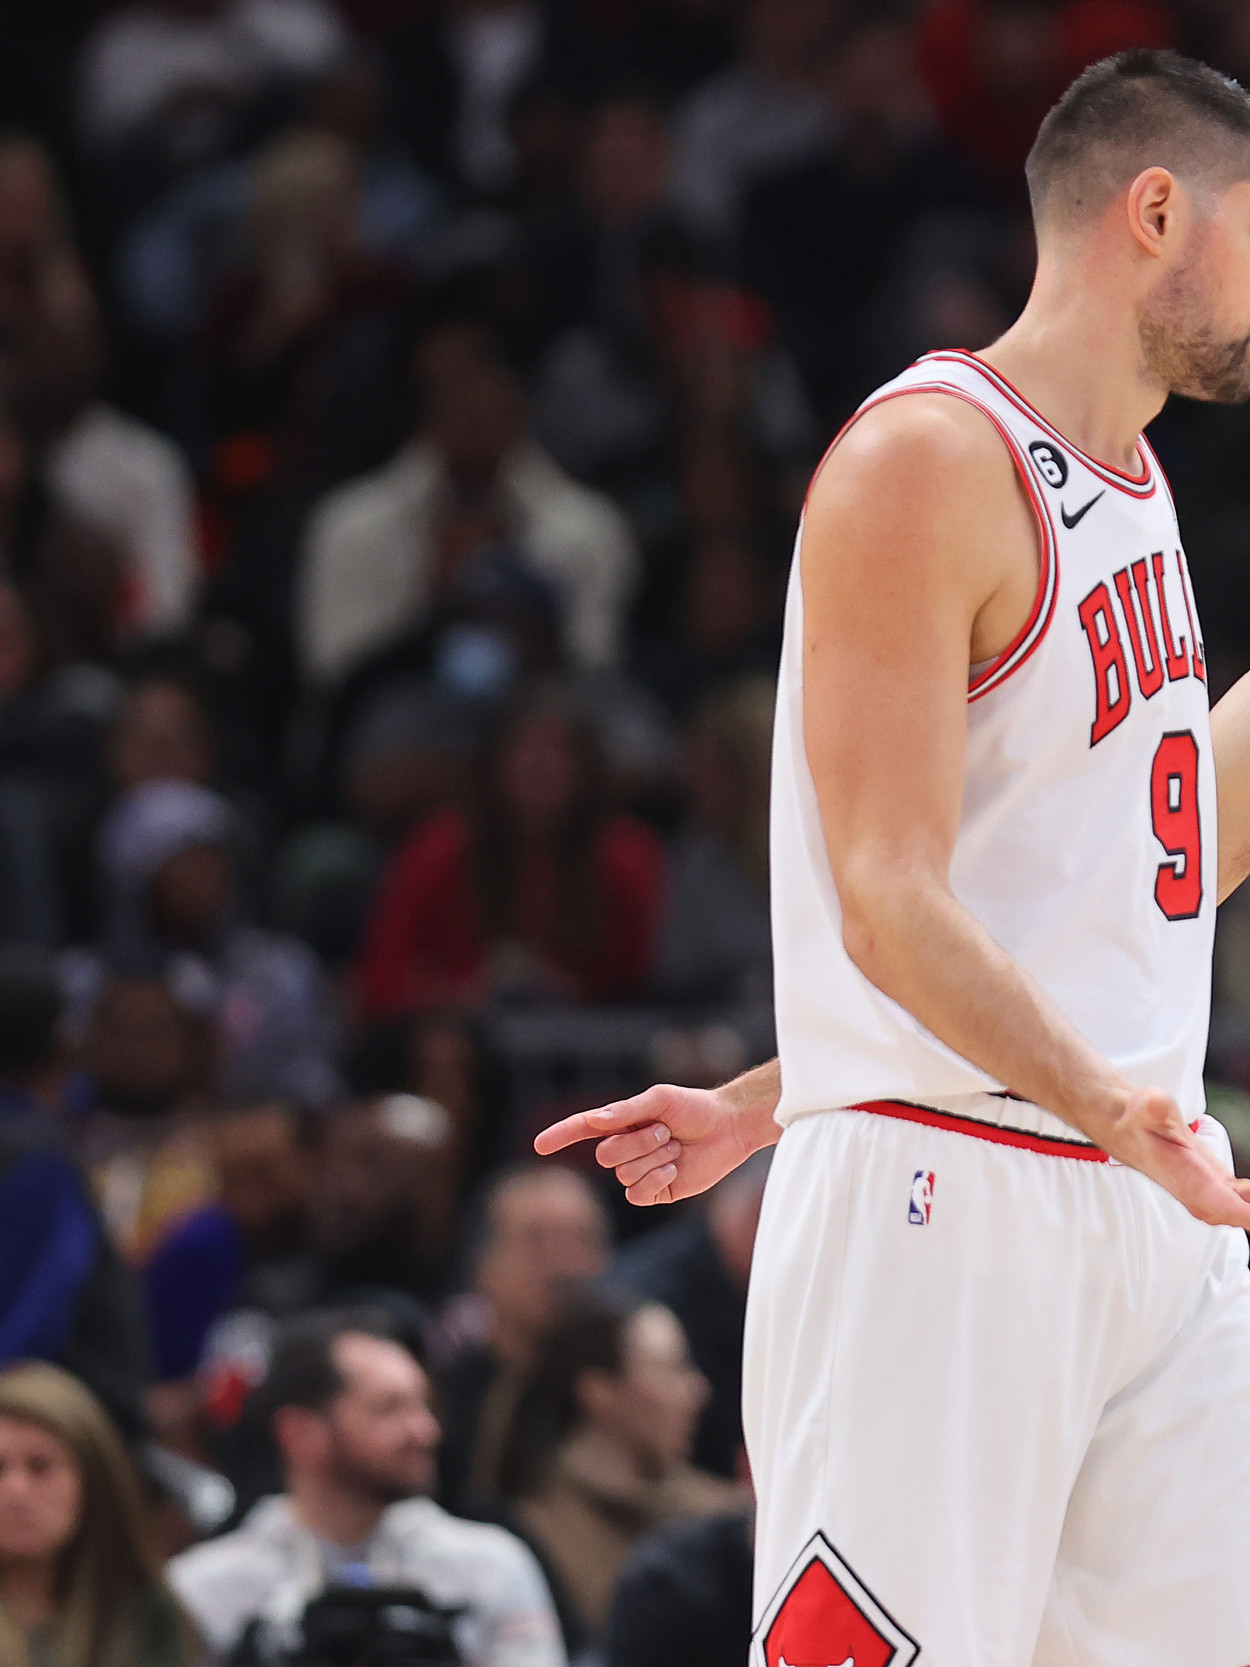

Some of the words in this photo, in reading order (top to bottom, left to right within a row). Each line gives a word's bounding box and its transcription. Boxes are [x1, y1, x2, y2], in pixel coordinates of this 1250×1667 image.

[1032, 446, 1063, 483] 6
[1078, 550, 1206, 749] BULL
[1150, 729, 1203, 921] 9
